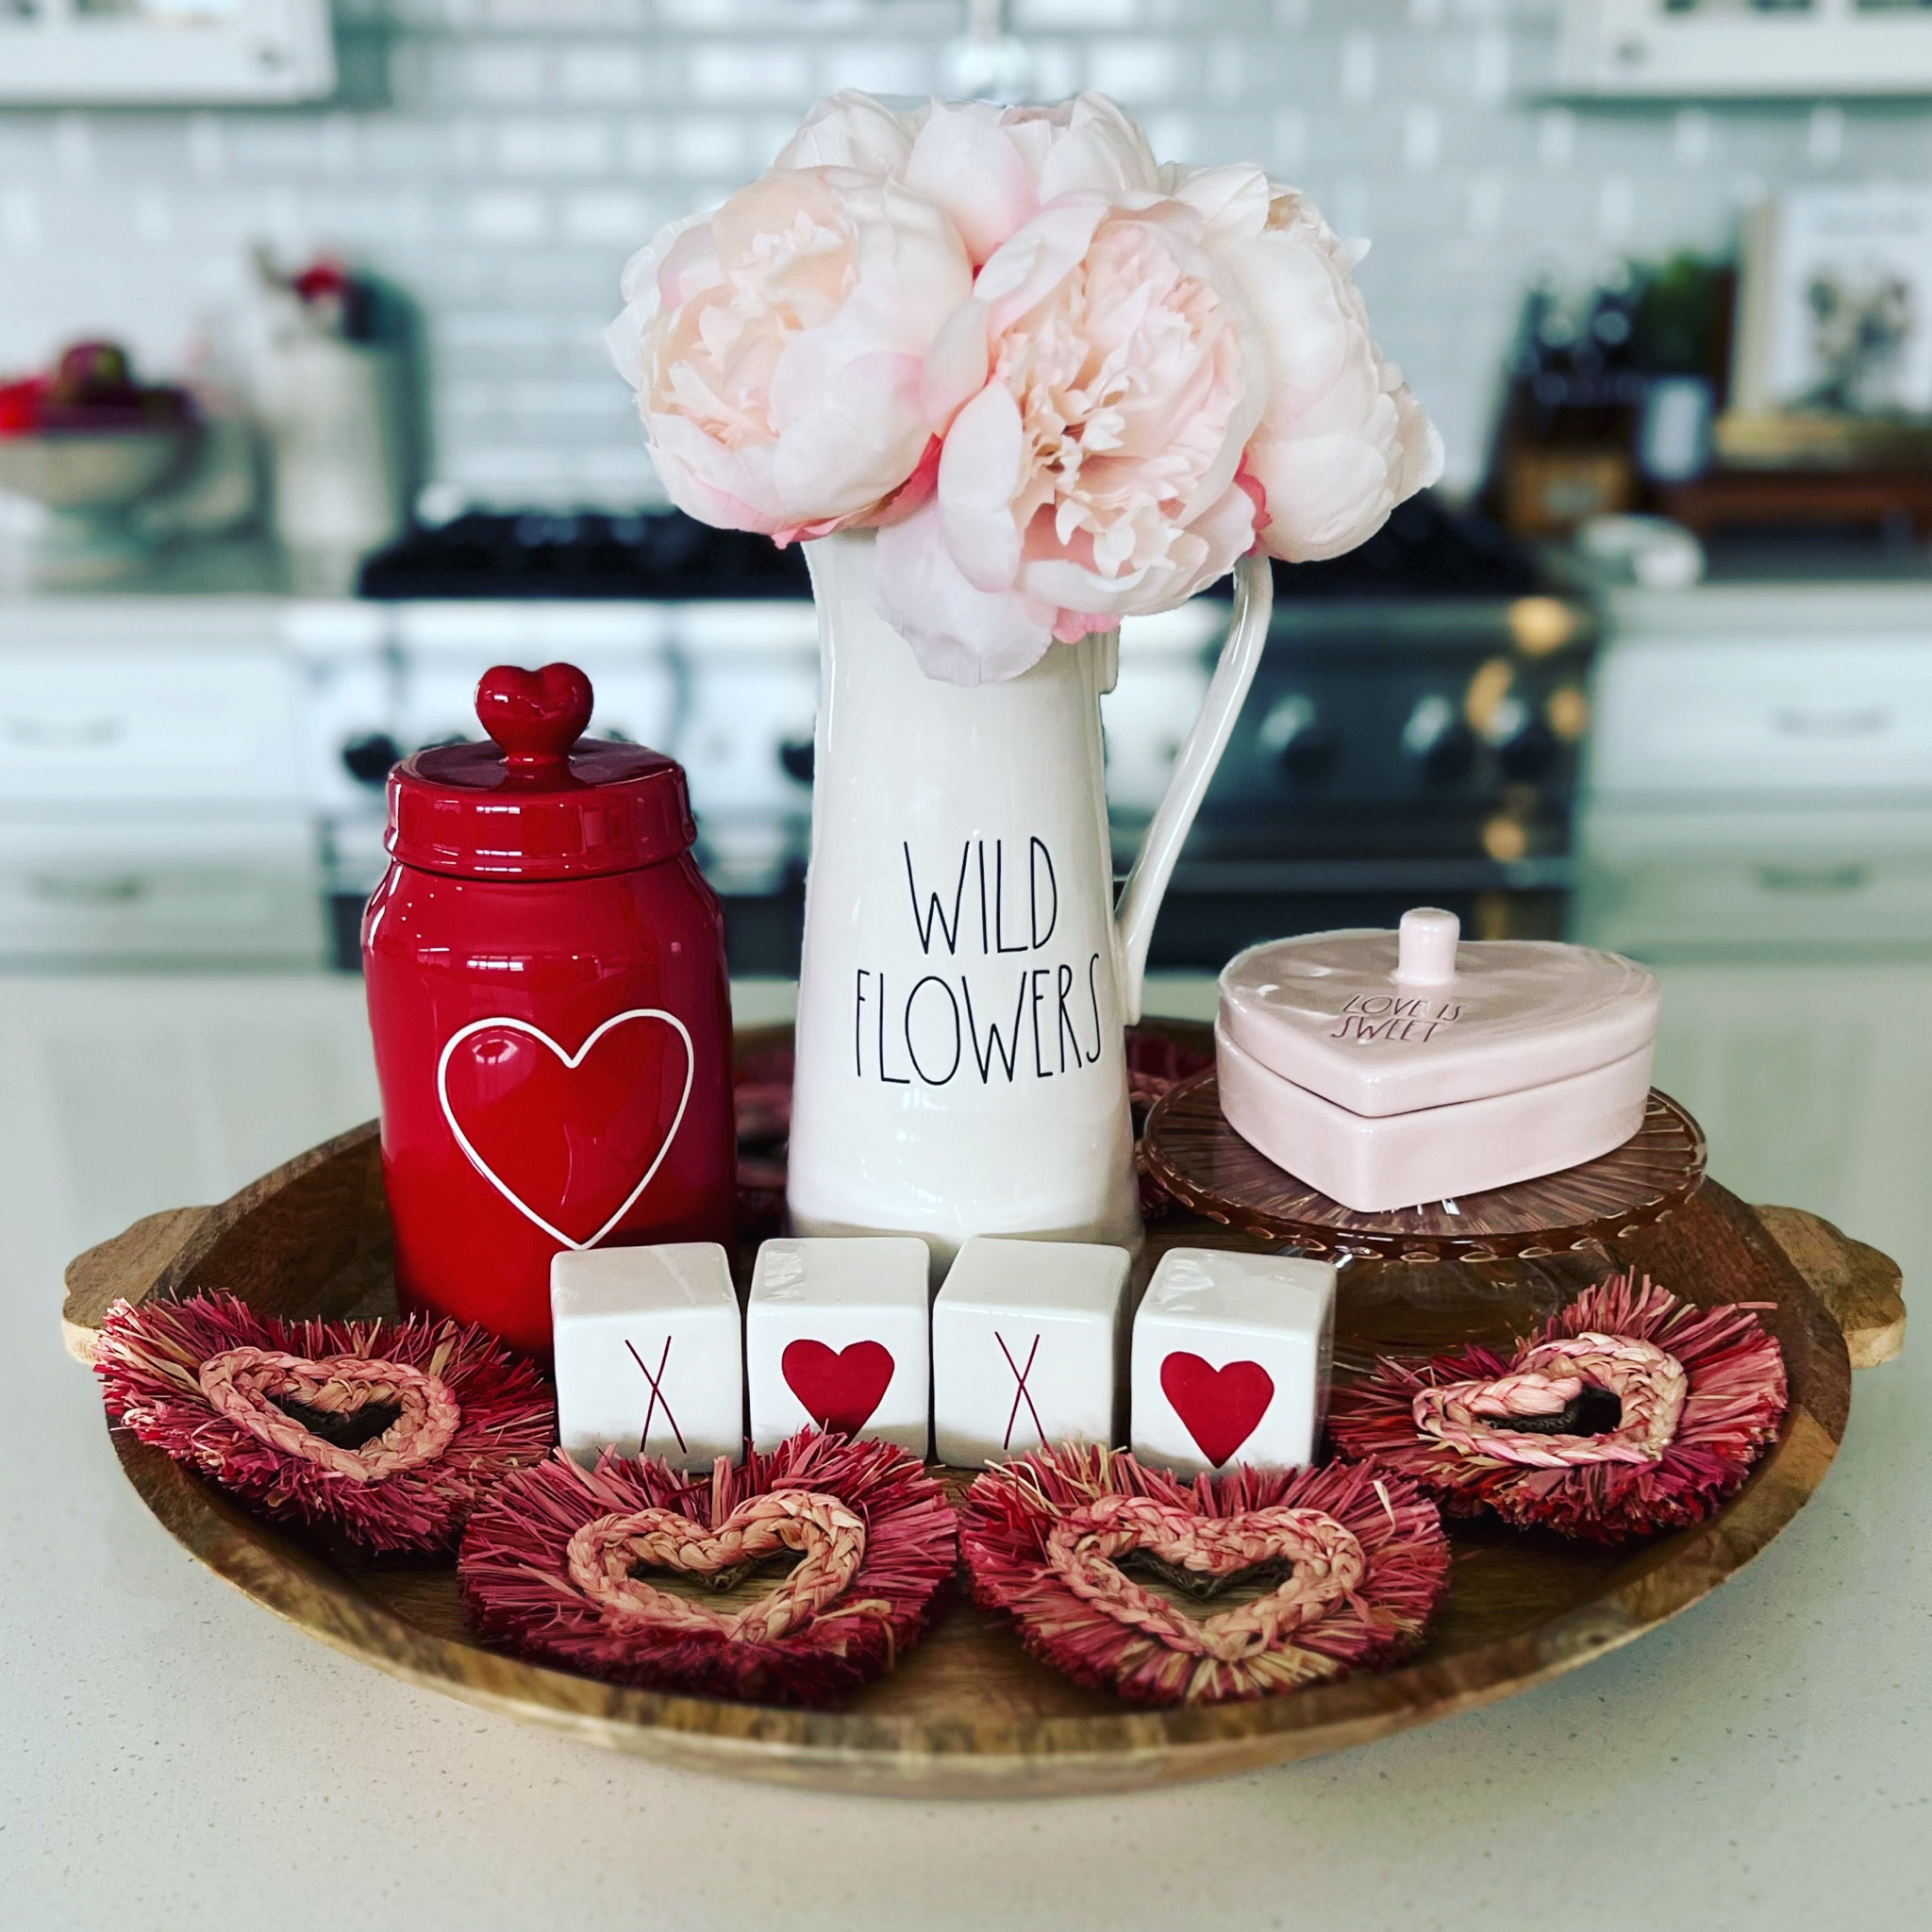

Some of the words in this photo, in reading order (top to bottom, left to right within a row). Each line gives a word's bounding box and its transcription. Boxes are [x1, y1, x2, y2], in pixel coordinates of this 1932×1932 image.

[904, 836, 1058, 955] WILD
[856, 953, 1101, 1086] FLOWERS
[1330, 1015, 1444, 1042] SWEET
[1342, 995, 1427, 1017] LOVE
[1436, 1004, 1467, 1022] IS
[625, 1335, 687, 1454] X
[994, 1331, 1049, 1451] X
